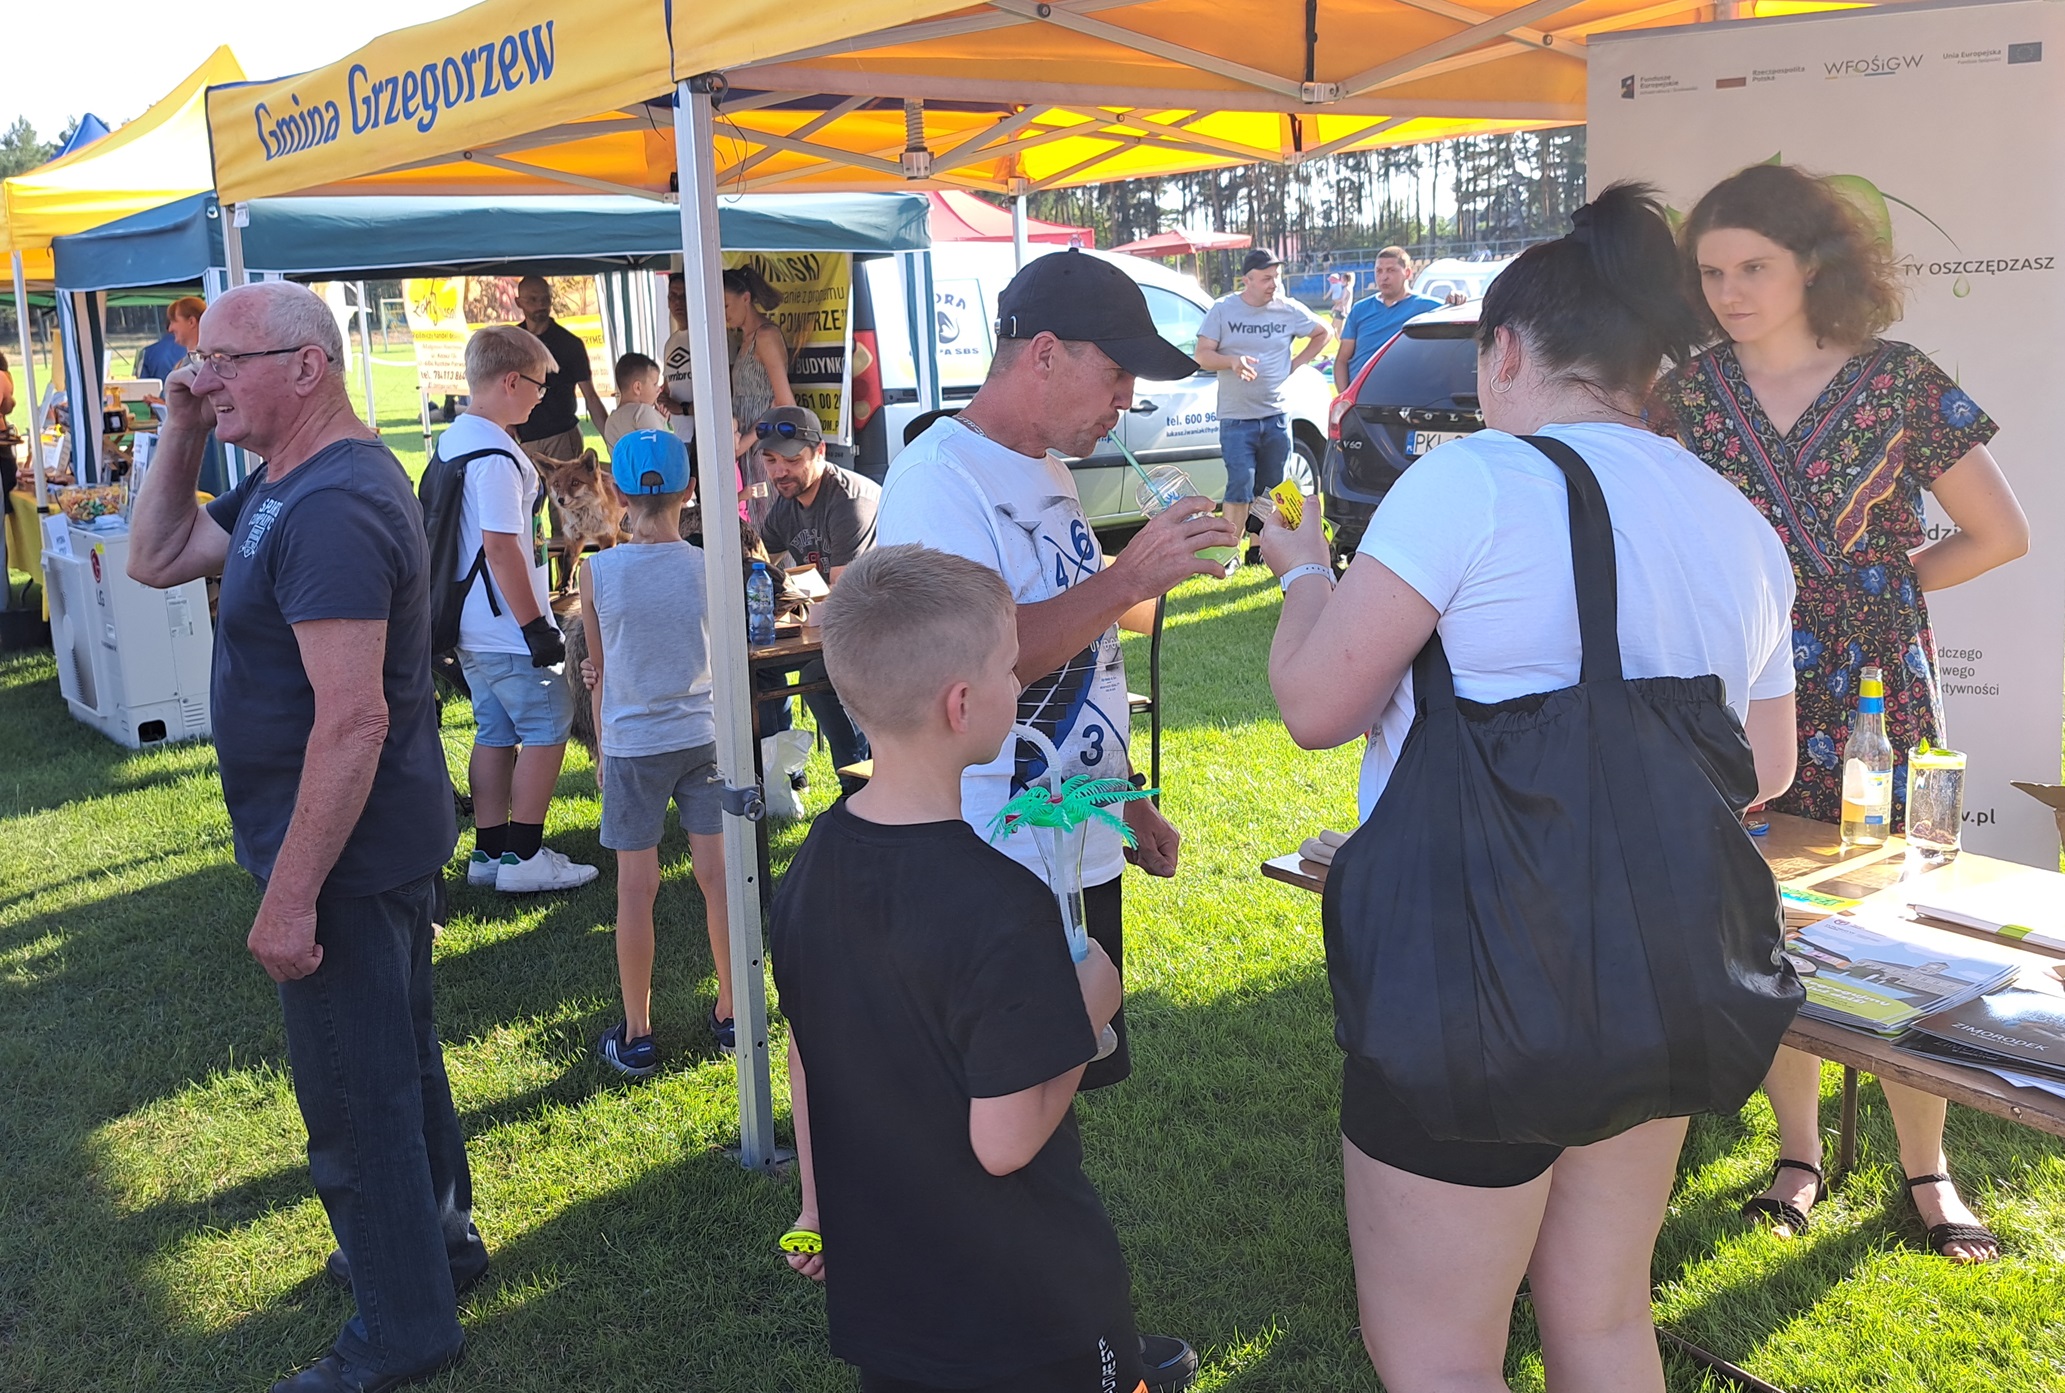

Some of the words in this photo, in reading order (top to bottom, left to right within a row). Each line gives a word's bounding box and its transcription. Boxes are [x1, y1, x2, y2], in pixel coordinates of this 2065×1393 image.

[1942, 52, 1959, 60] Unia
[1961, 48, 2002, 60] Europejska
[254, 93, 341, 161] Gmina
[348, 19, 555, 135] Grzegorzew
[1903, 263, 1924, 276] TY
[1929, 256, 2055, 277] OSZCZĘDZASZ
[1227, 320, 1287, 339] Wrangler
[819, 393, 832, 410] 00
[1166, 416, 1182, 427] tel.
[1185, 414, 1202, 425] 600
[1343, 440, 1362, 449] V60
[1070, 519, 1095, 561] 6
[1080, 724, 1105, 767] 3
[1951, 1022, 2050, 1051] ZIMORODEK
